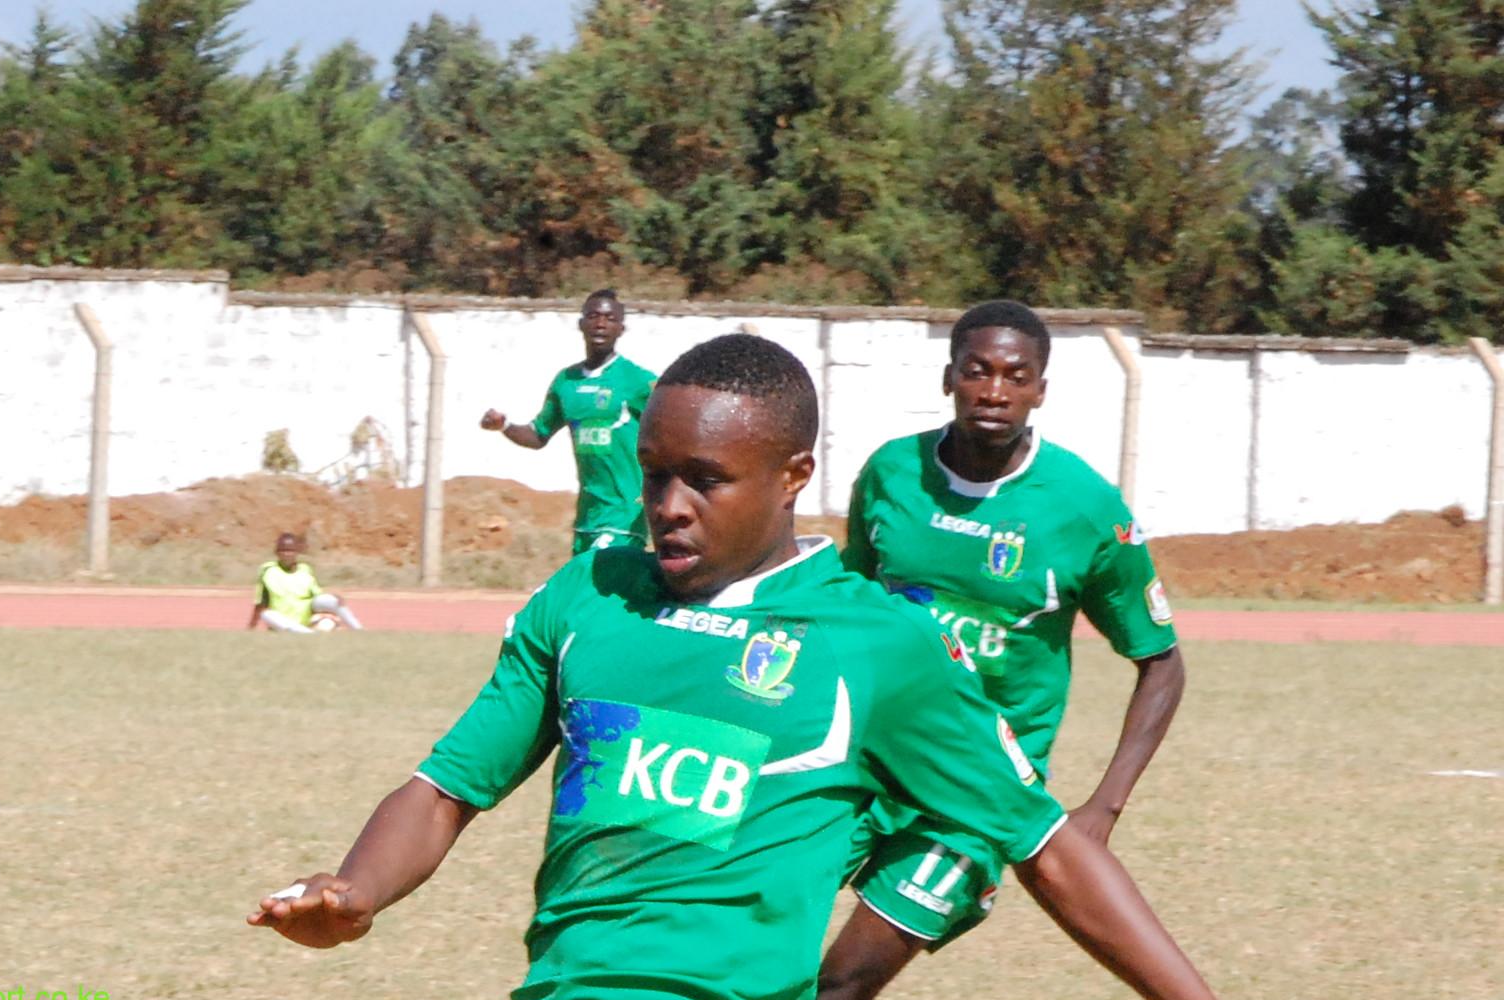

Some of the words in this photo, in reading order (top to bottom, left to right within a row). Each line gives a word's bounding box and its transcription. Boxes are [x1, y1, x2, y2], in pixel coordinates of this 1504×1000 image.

[579, 427, 611, 445] KCB
[929, 512, 992, 539] LEGEA
[654, 607, 749, 640] LEGEA
[617, 738, 750, 818] KCB
[911, 842, 972, 897] 11
